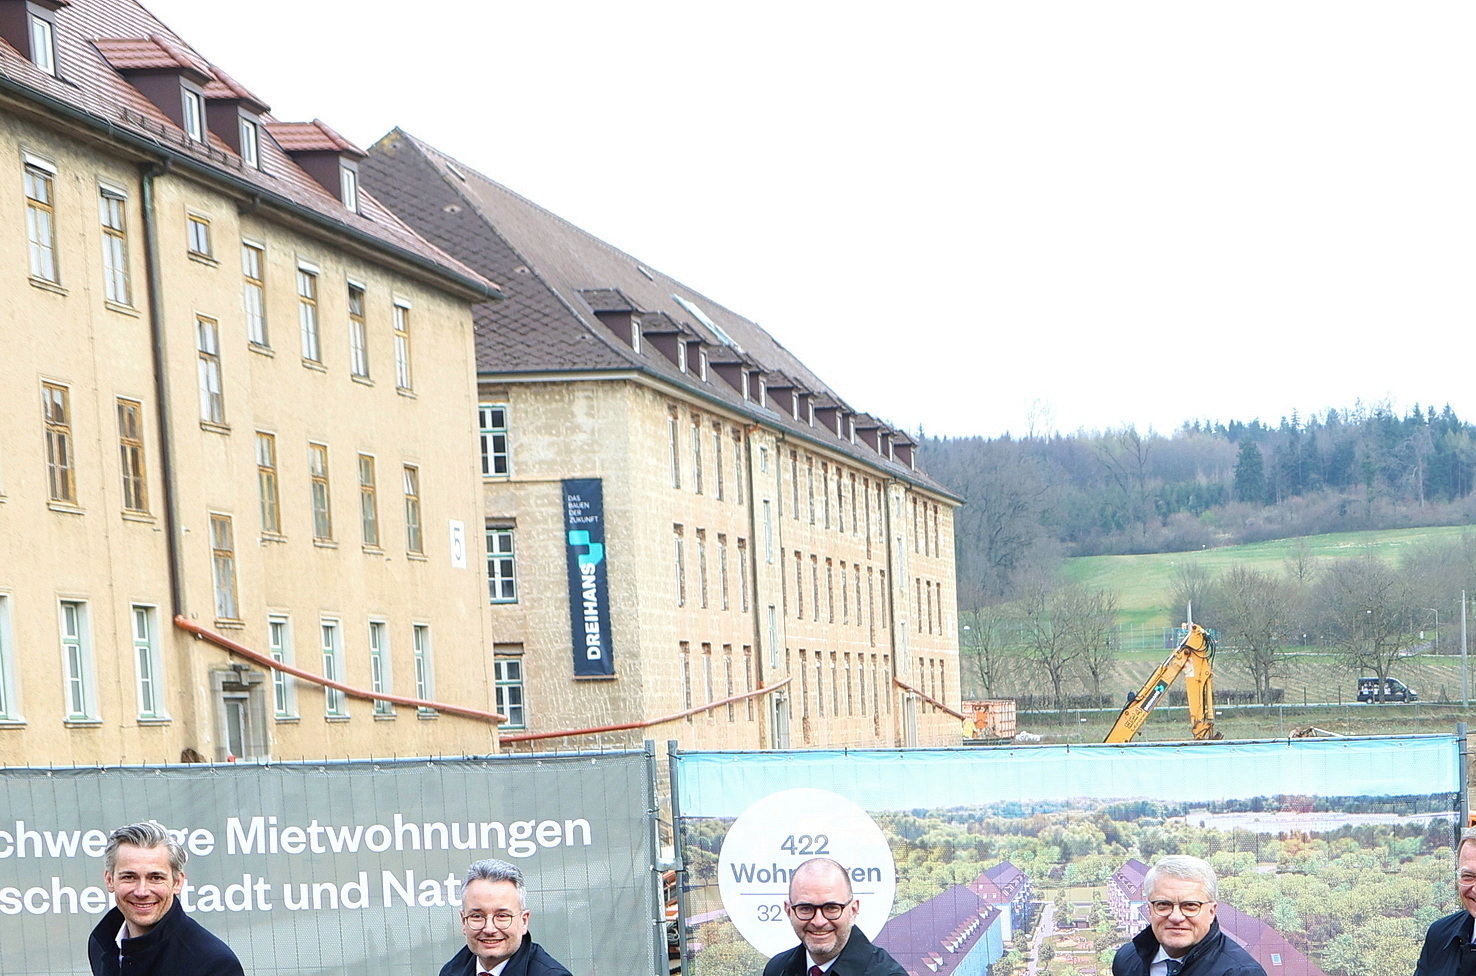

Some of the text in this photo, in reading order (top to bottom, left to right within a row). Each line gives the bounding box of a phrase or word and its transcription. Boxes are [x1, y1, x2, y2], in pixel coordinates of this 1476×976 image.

[569, 516, 599, 524] ZUKUNFT
[453, 527, 462, 561] 5
[580, 562, 602, 661] DREIHANS
[226, 814, 592, 858] Mietwohnungen
[780, 834, 830, 855] 422
[0, 876, 117, 915] sche
[180, 873, 273, 913] tadt
[283, 872, 370, 911] und
